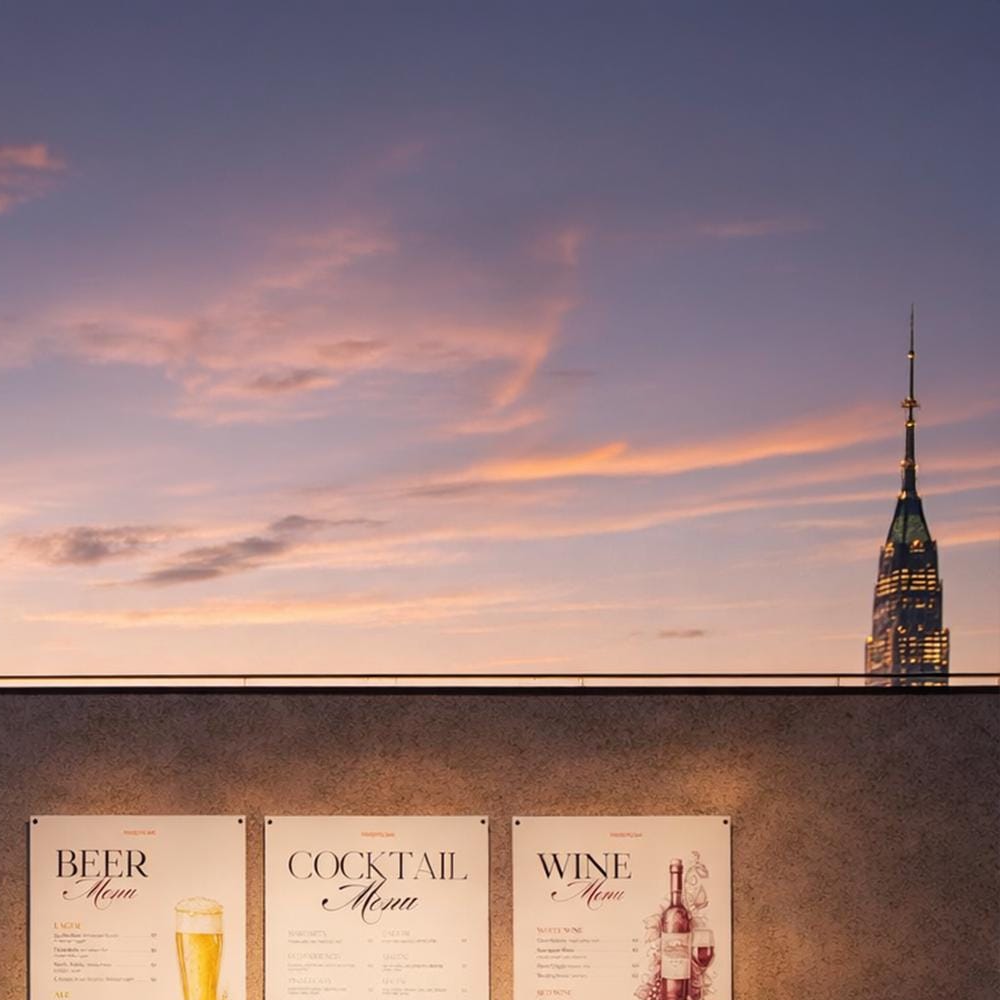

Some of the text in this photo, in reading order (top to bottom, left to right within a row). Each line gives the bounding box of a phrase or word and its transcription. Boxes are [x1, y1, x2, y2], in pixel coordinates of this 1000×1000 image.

[56, 849, 148, 878] BEER
[288, 850, 469, 881] COCKTAIL
[536, 852, 632, 880] WINE
[62, 877, 137, 911] Menu
[321, 879, 419, 925] Menu
[551, 878, 625, 911] Menu
